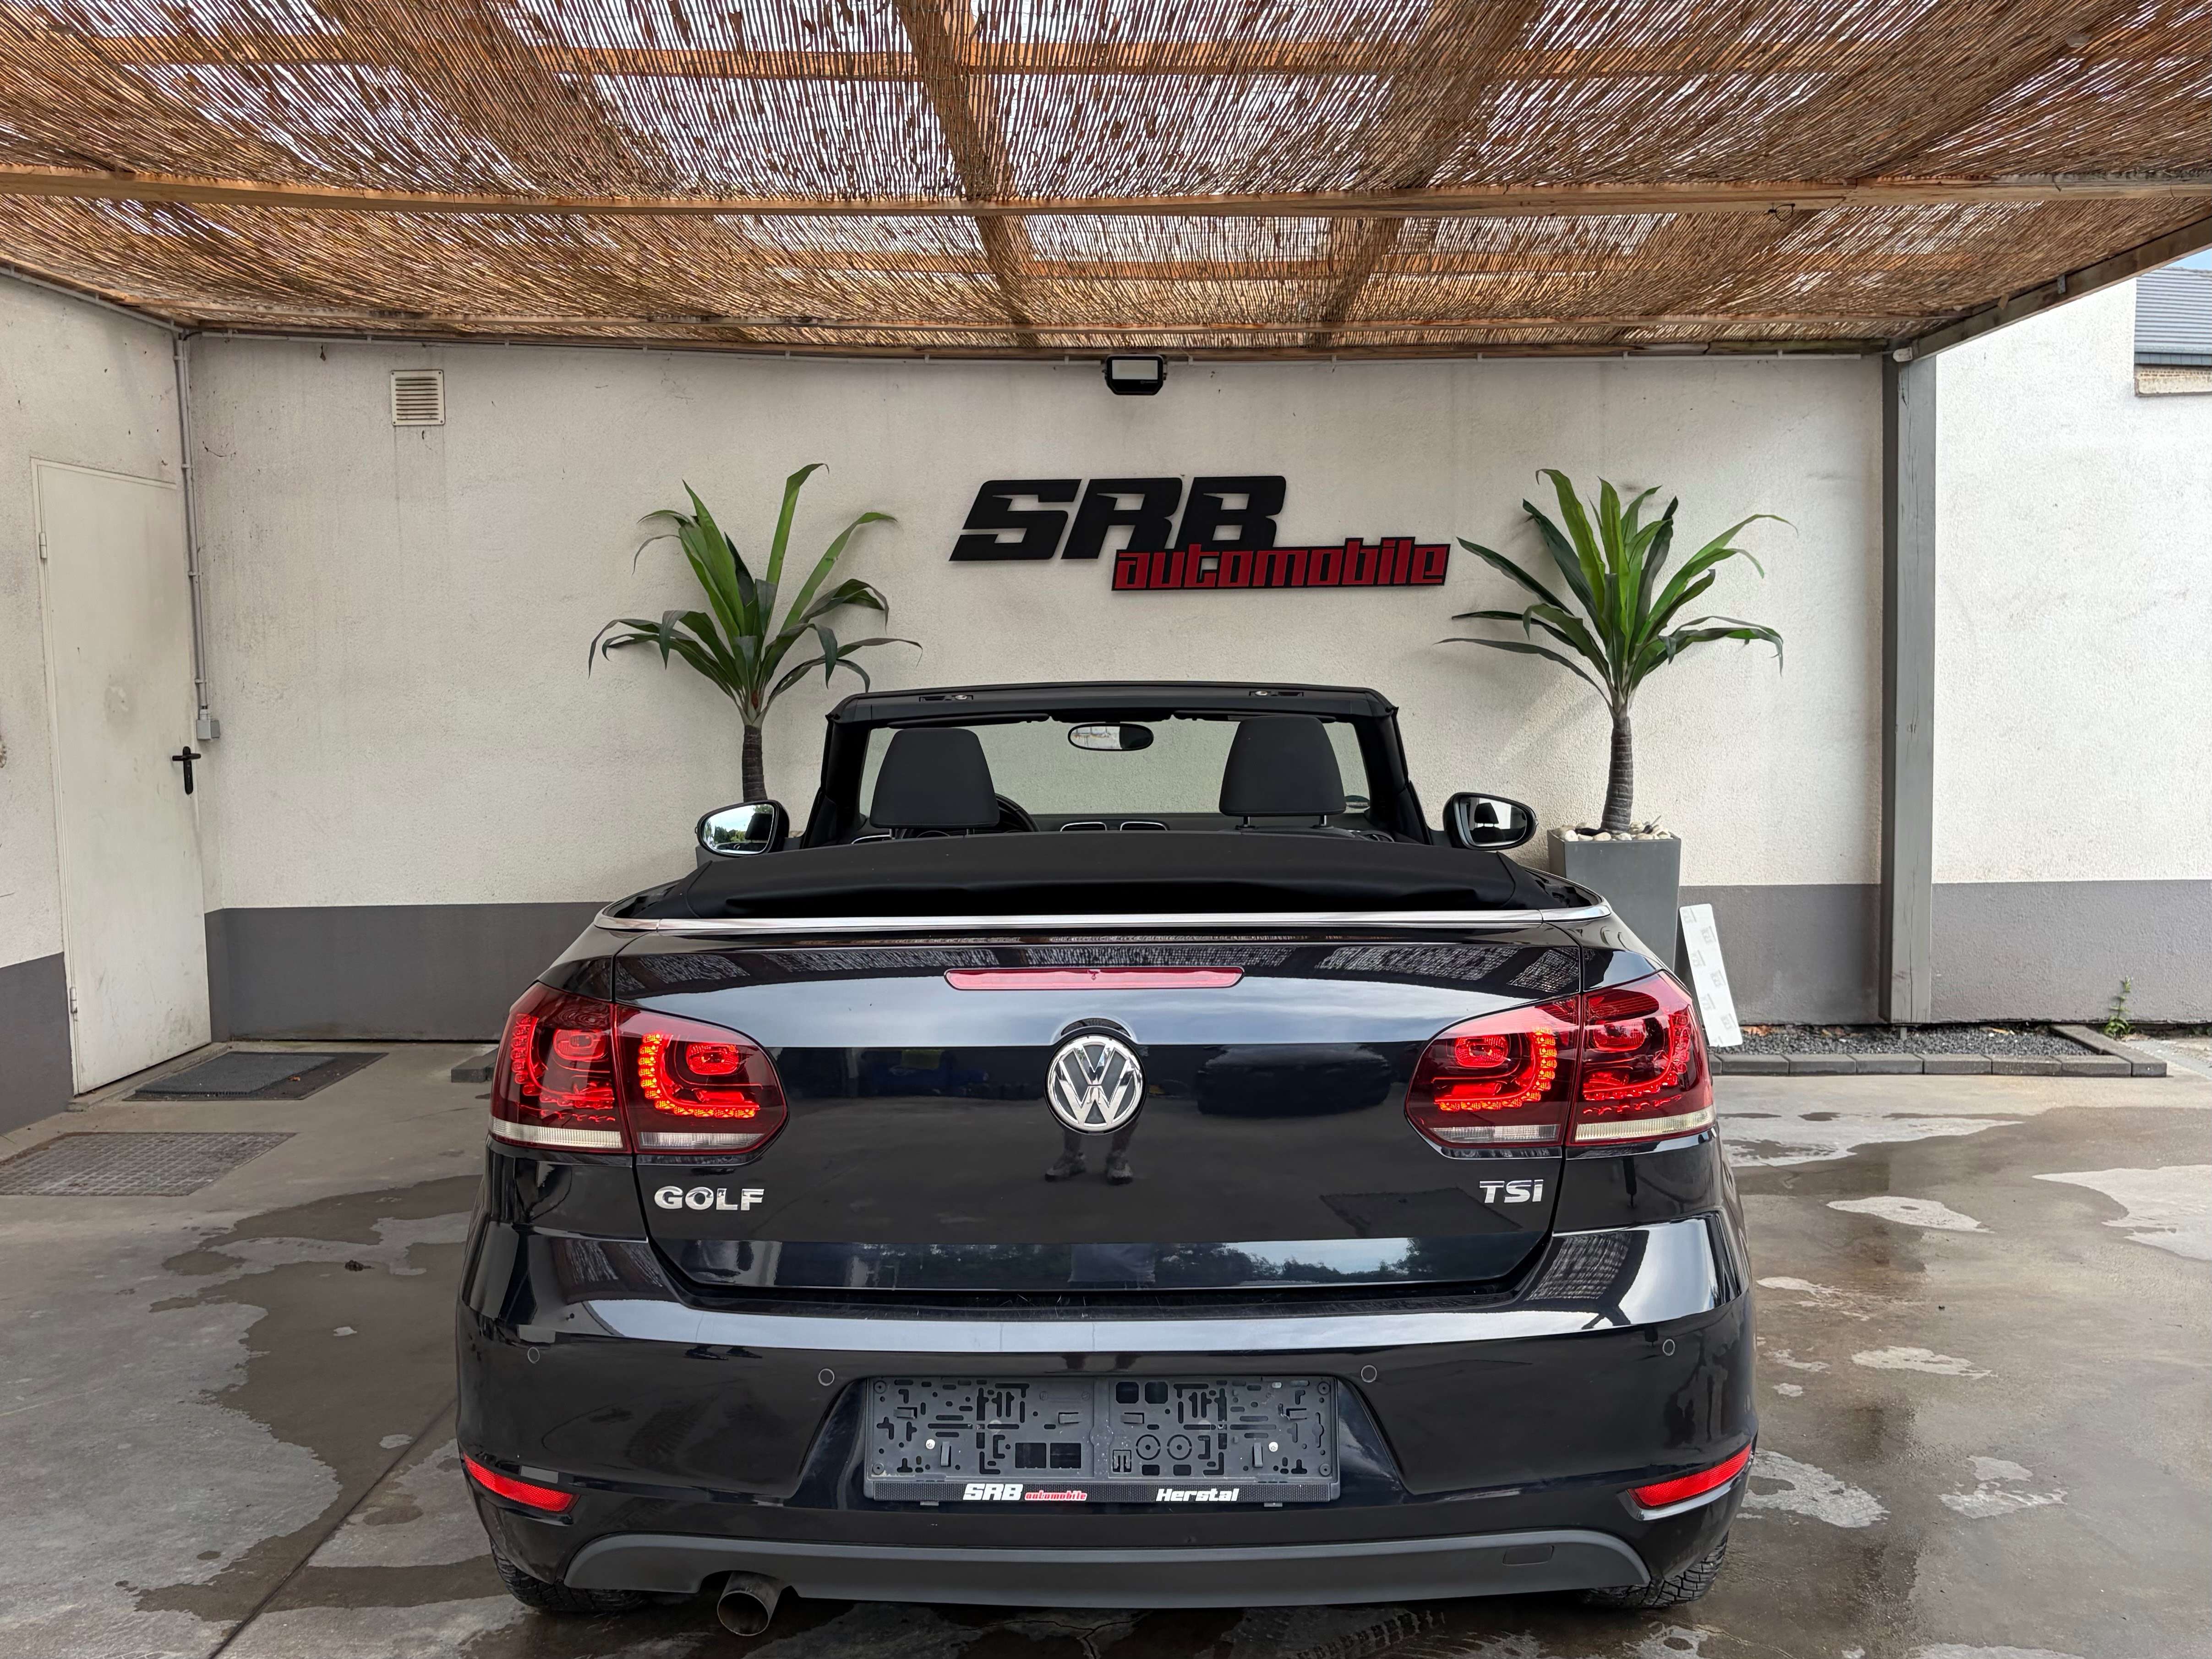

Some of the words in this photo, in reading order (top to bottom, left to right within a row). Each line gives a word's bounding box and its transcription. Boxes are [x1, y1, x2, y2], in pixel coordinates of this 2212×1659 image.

[949, 475, 1286, 561] SRB
[1112, 537, 1450, 591] automobile
[654, 1185, 765, 1211] GOLF
[963, 1483, 1023, 1501] SRB
[1025, 1490, 1087, 1501] automobile
[1156, 1488, 1240, 1501] Herstal
